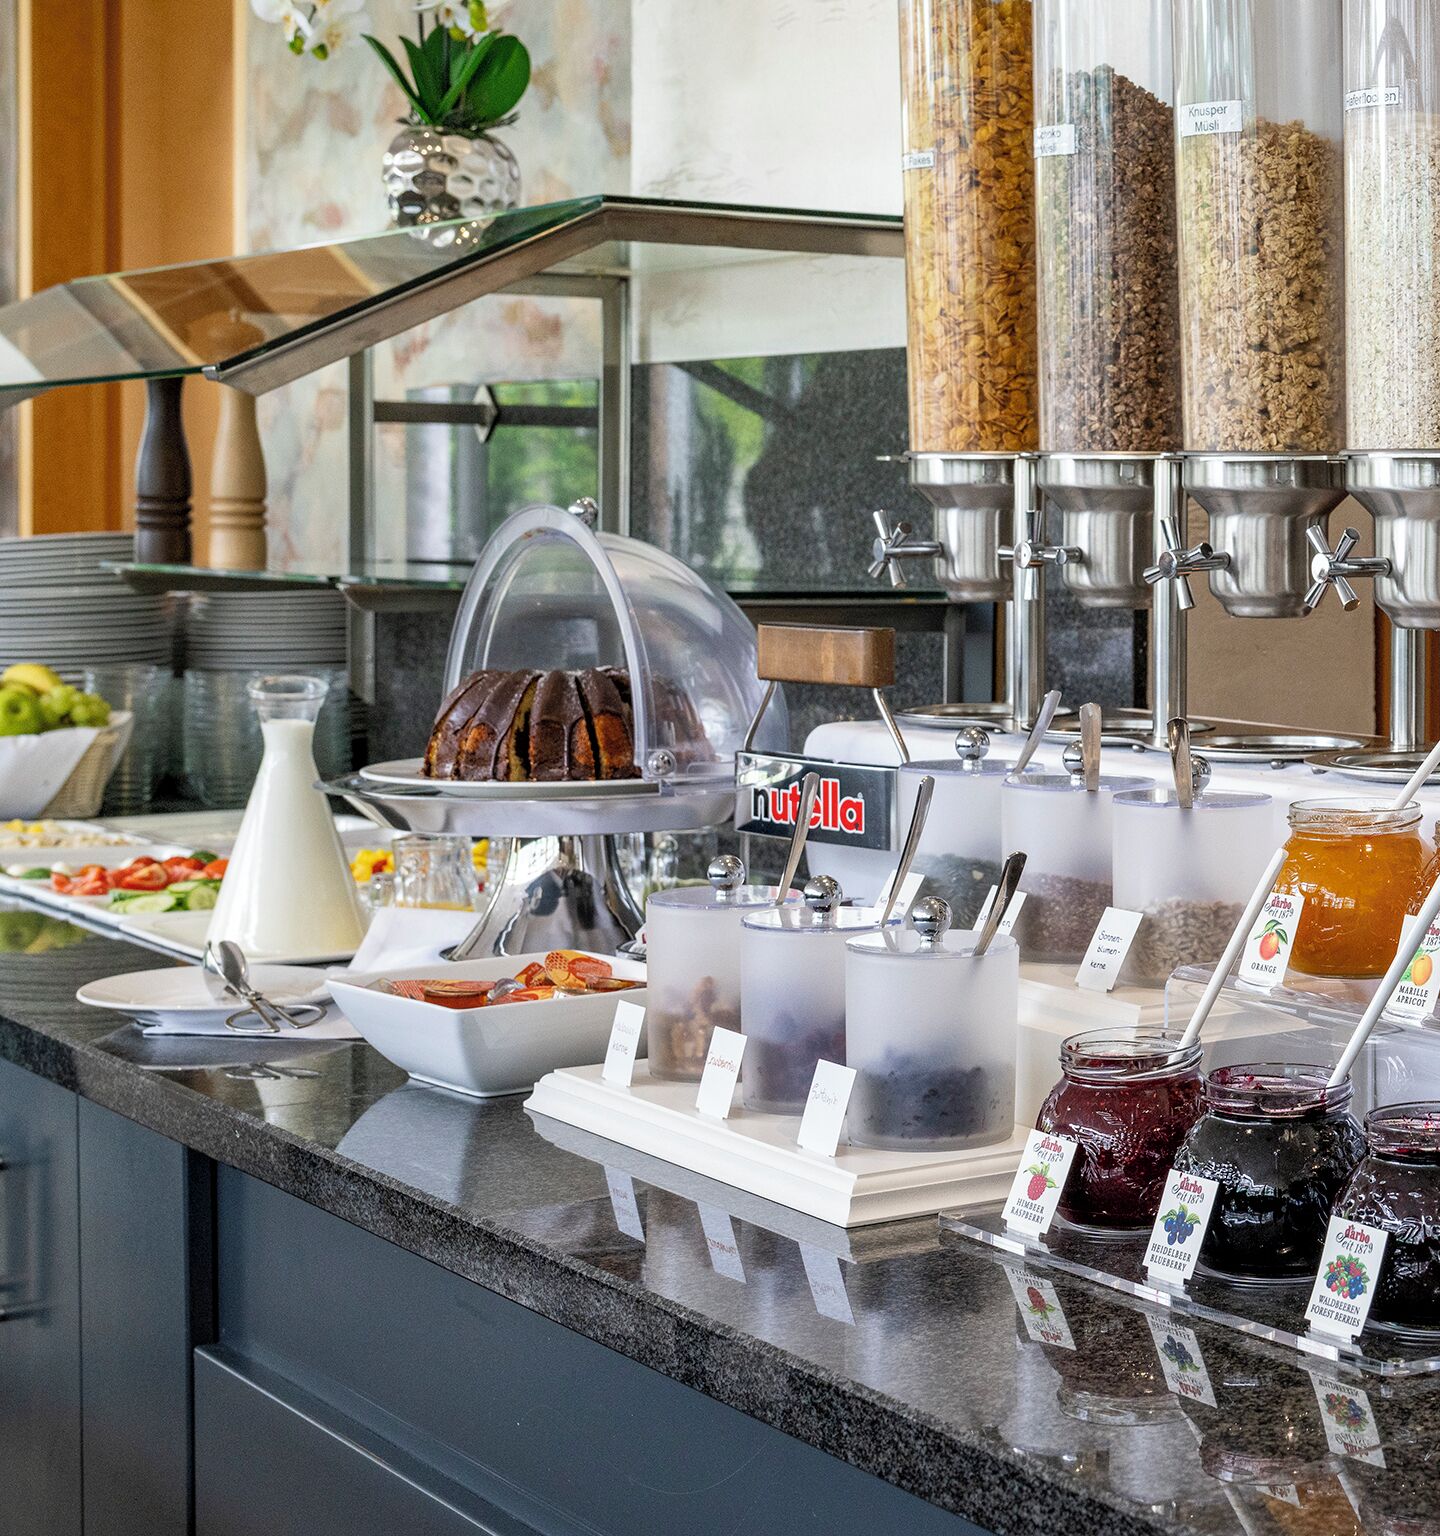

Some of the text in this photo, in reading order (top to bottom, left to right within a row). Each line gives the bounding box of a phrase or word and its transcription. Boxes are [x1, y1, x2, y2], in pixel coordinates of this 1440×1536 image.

[1188, 105, 1228, 117] Knusper
[1195, 119, 1219, 132] Müsli
[1278, 908, 1294, 919] 1879
[1250, 961, 1277, 974] ORANGE
[1398, 985, 1429, 998] MARILLE
[1395, 995, 1427, 1007] APRICOT
[1033, 1142, 1065, 1162] Seit 1879
[1171, 1183, 1205, 1205] Seit 1879
[1010, 1206, 1045, 1224] RASPBERRY
[1016, 1198, 1045, 1214] HIMBEER
[1150, 1242, 1192, 1262] HEIDELBEER
[1335, 1232, 1374, 1255] Seit 1879
[1149, 1253, 1187, 1272] BLUEBERRY
[1318, 1294, 1360, 1315] WALDBEEREN
[1310, 1304, 1361, 1328] FOREST BERRIES
